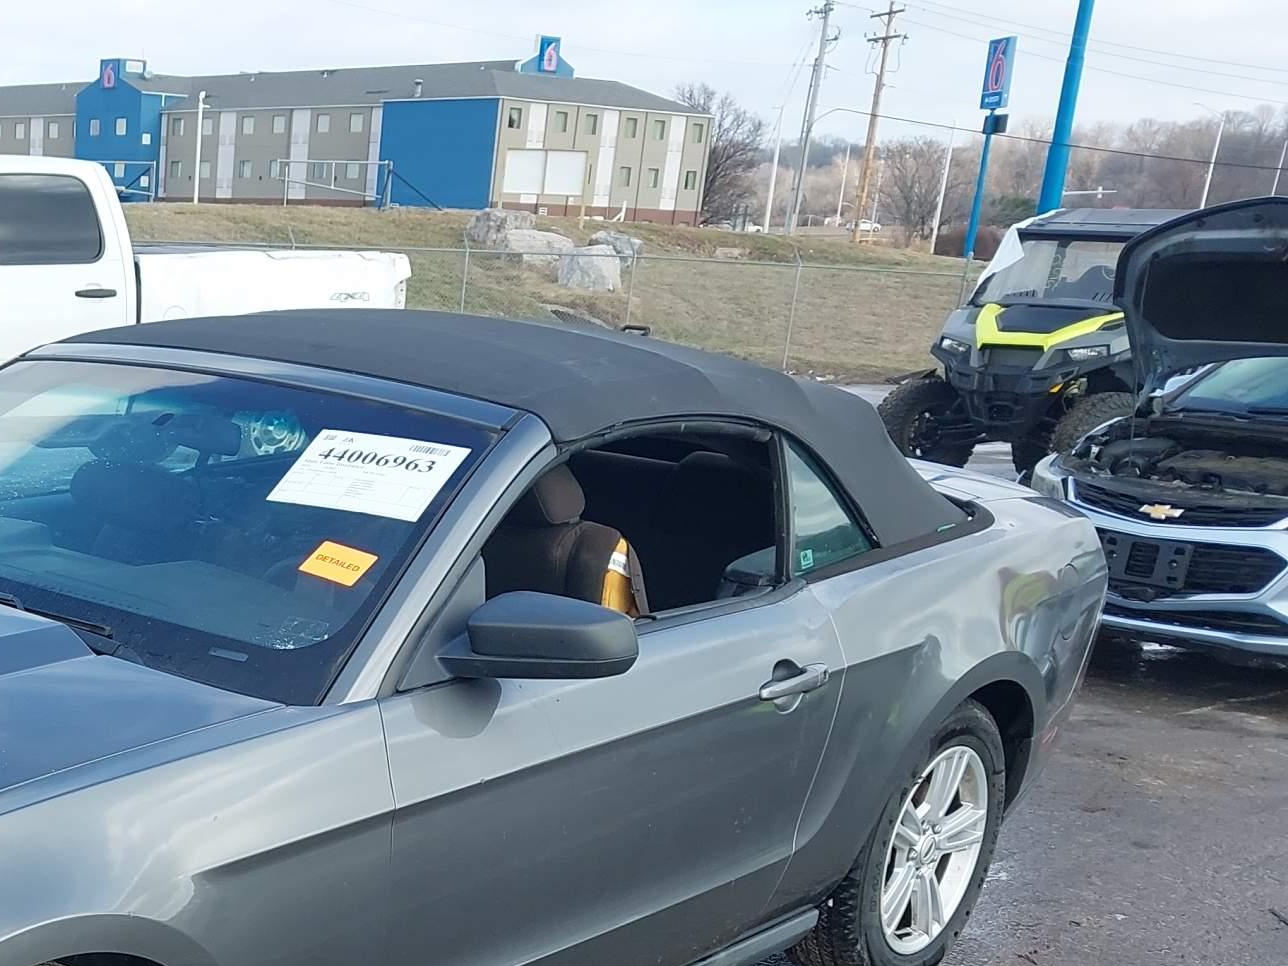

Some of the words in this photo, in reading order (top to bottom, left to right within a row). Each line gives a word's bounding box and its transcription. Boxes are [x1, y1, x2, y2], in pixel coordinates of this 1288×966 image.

[544, 42, 557, 70] 6
[989, 39, 1006, 92] 6
[104, 63, 115, 88] 6
[318, 447, 435, 473] 44006963
[315, 553, 360, 572] DETAILED
